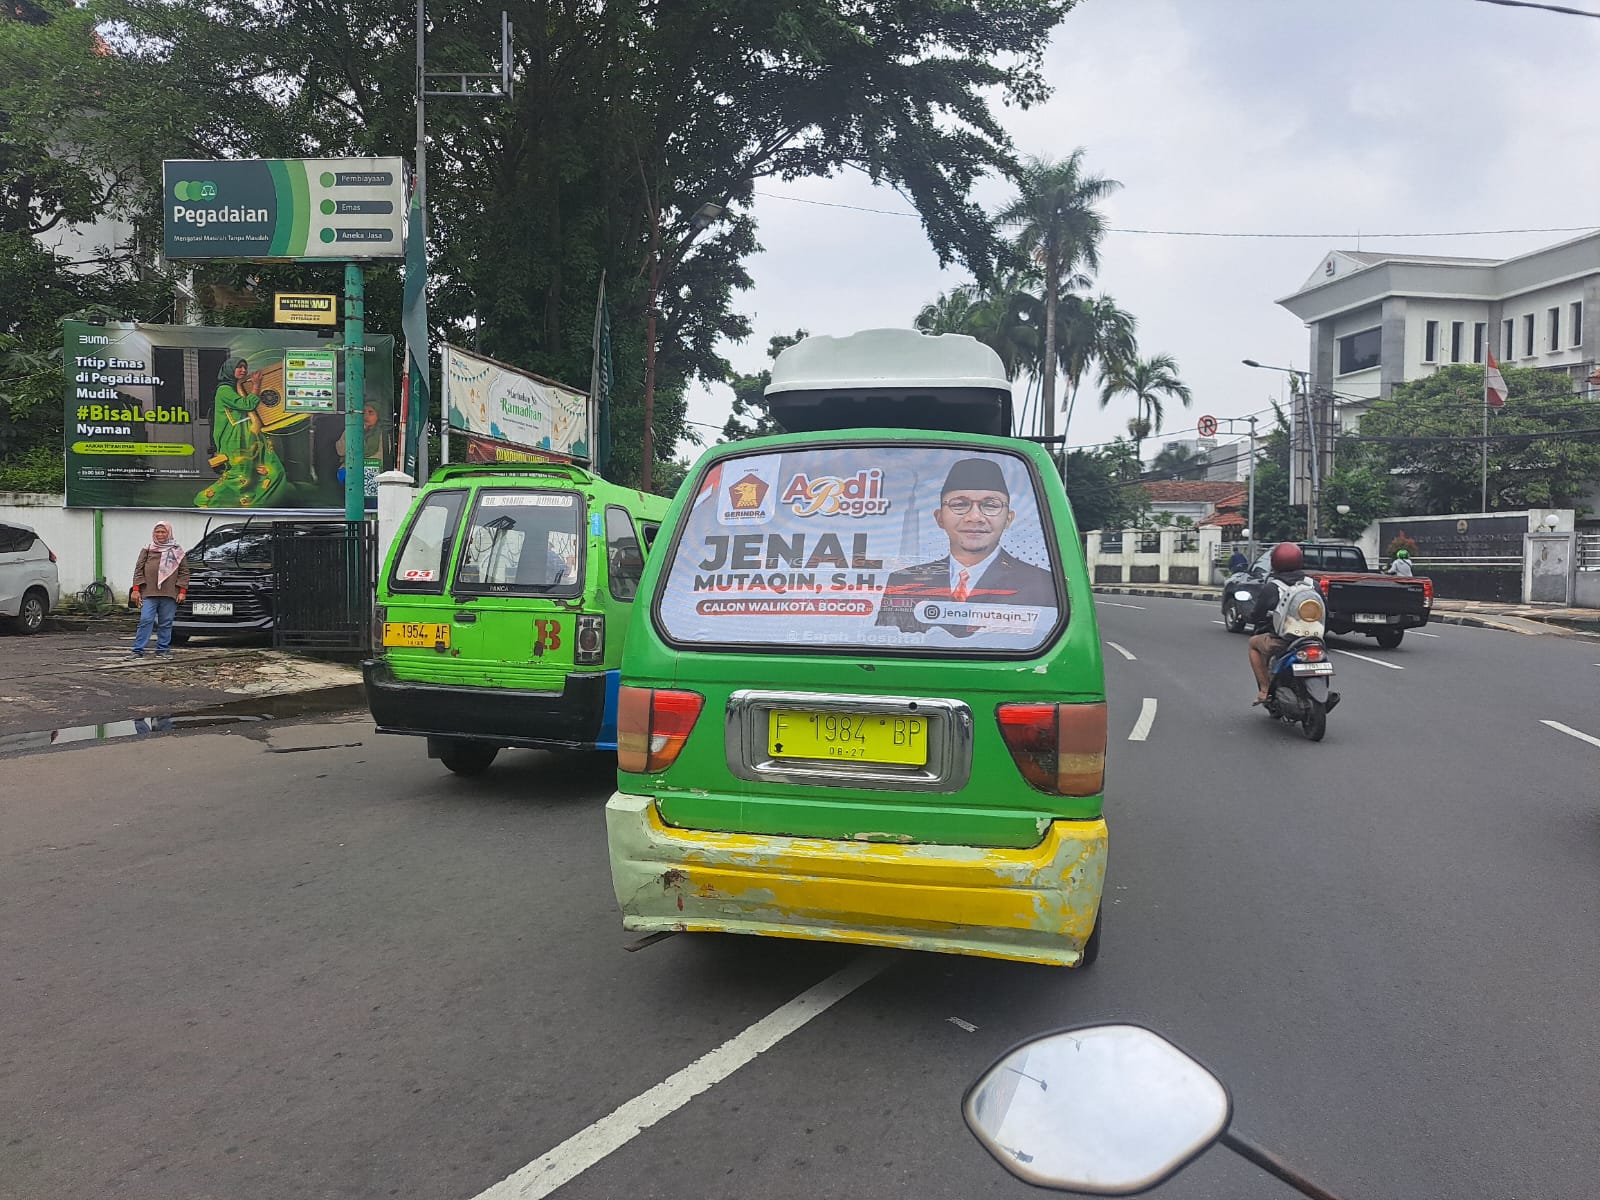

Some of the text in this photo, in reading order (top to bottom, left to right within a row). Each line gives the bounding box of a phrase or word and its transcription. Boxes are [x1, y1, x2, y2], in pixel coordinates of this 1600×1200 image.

[342, 203, 361, 211] Emas
[174, 205, 268, 227] Pegadaian
[75, 356, 144, 369] Titip Emas
[76, 372, 164, 386] di Pegadaian,
[77, 388, 118, 399] Mudik
[76, 405, 190, 423] #BisaLebih
[500, 397, 542, 422] Ramadhan
[77, 424, 131, 436] Nyaman
[724, 510, 766, 518] GERINDRA
[698, 533, 883, 571] JENAL
[406, 570, 431, 578] 03
[693, 573, 883, 594] MUTAQIN, S.H.
[702, 601, 866, 612] CALON WALIKOTA BOGOR
[942, 607, 1039, 622] jenalmutaqin_17
[385, 624, 448, 640] F 1954 AF
[534, 619, 561, 651] B
[775, 713, 921, 747] F 1984 BP
